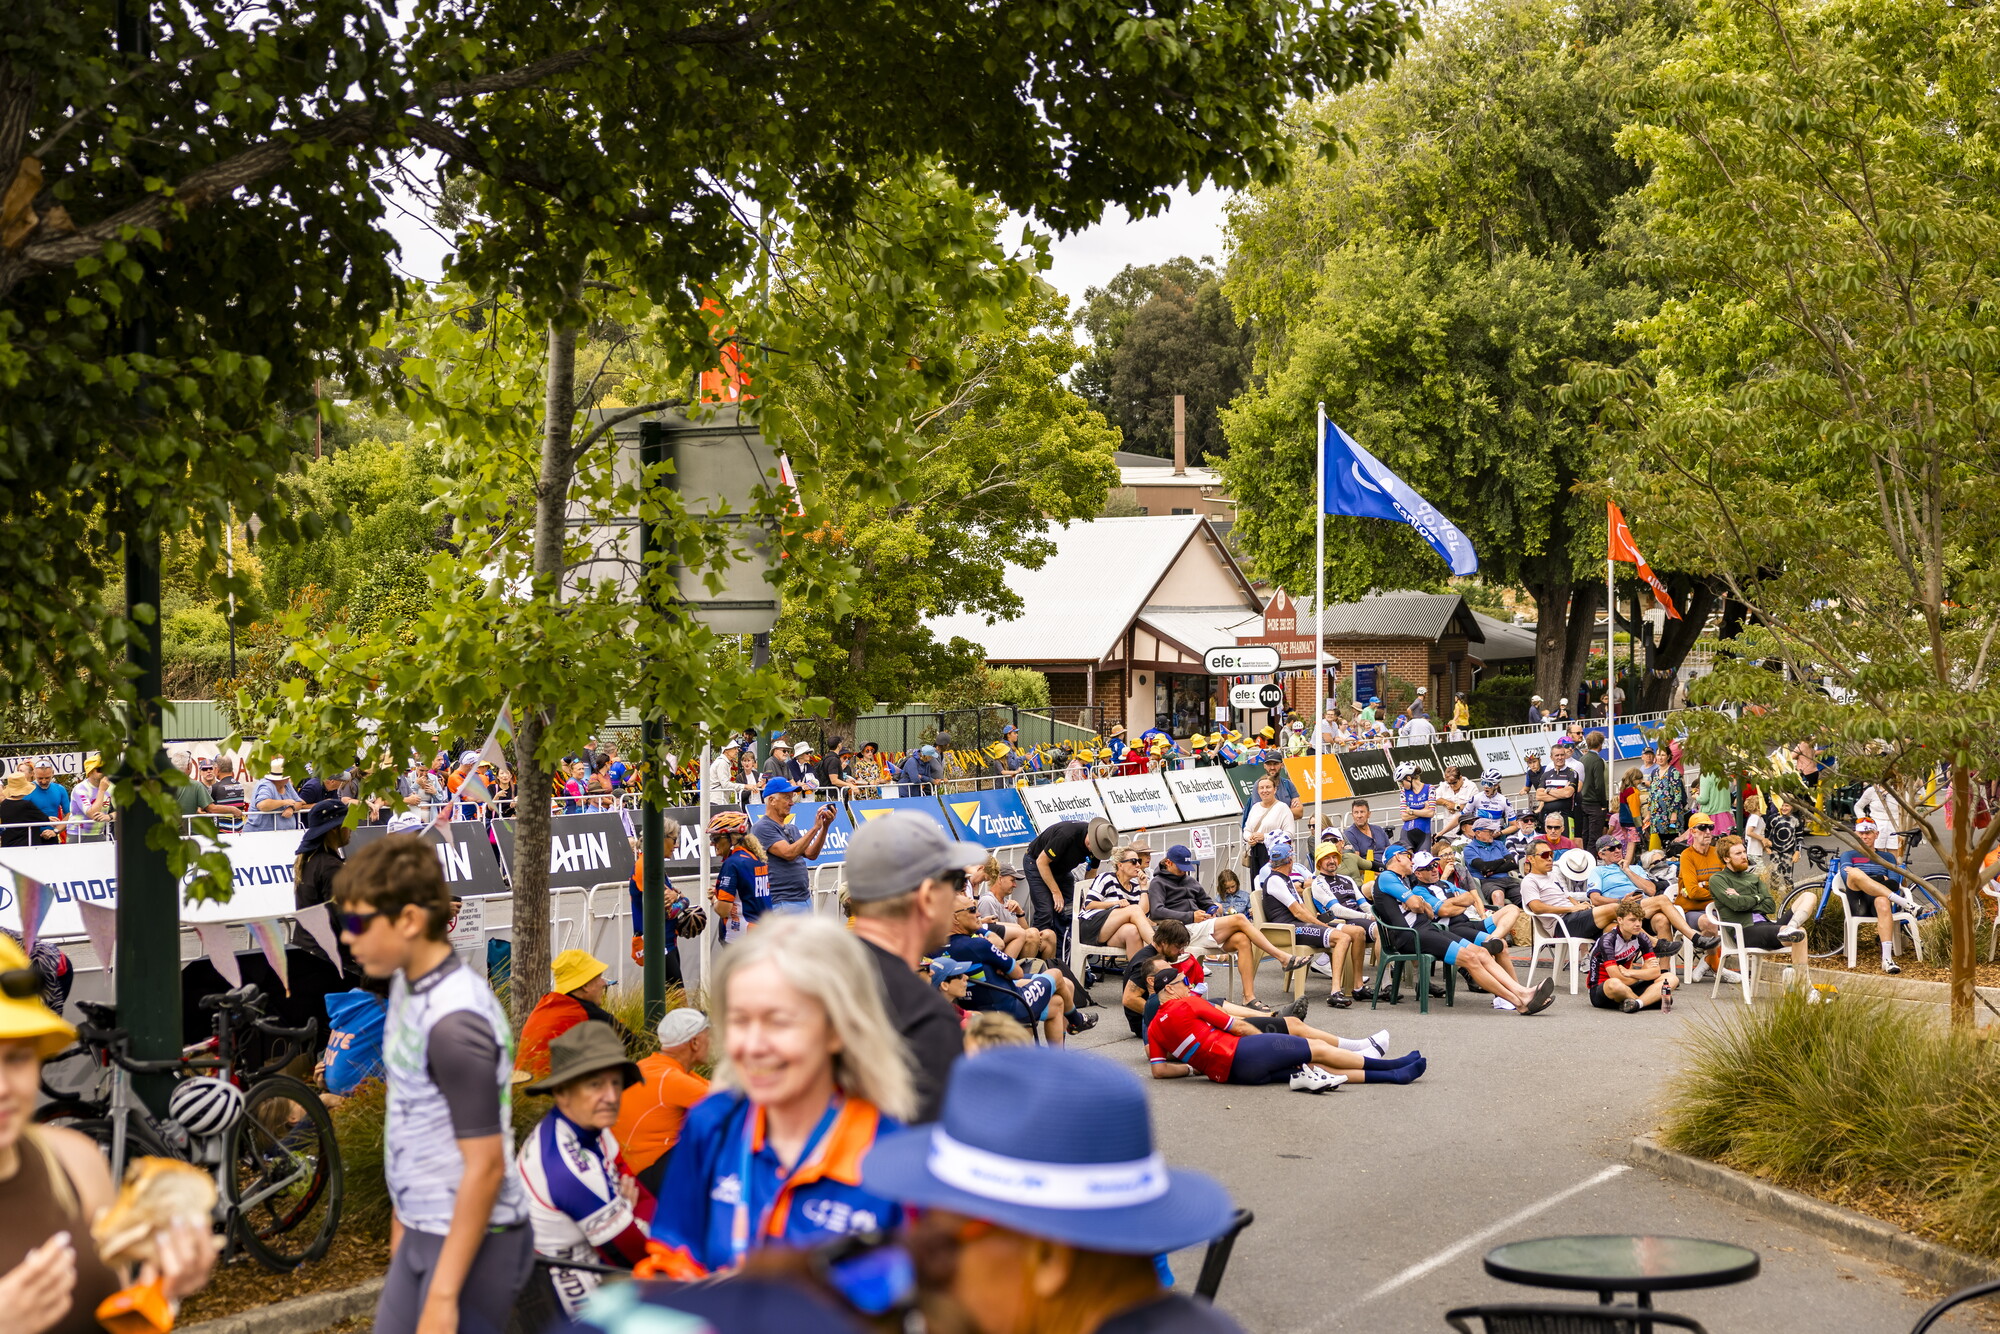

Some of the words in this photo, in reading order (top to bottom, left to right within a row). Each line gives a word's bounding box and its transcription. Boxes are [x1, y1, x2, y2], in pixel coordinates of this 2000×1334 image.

[1290, 641, 1315, 654] PHARMACY
[1212, 655, 1241, 668] efex
[1261, 691, 1280, 702] 100
[1837, 694, 1855, 703] efe
[1175, 781, 1190, 794] The
[1190, 778, 1225, 793] Advertiser
[1108, 791, 1124, 804] The
[1124, 788, 1161, 803] Advertiser
[1035, 799, 1051, 814] The
[1053, 796, 1092, 812] Advertiser
[981, 811, 1026, 838] Ziptrak
[550, 831, 611, 874] AHN
[755, 875, 770, 898] EPIC
